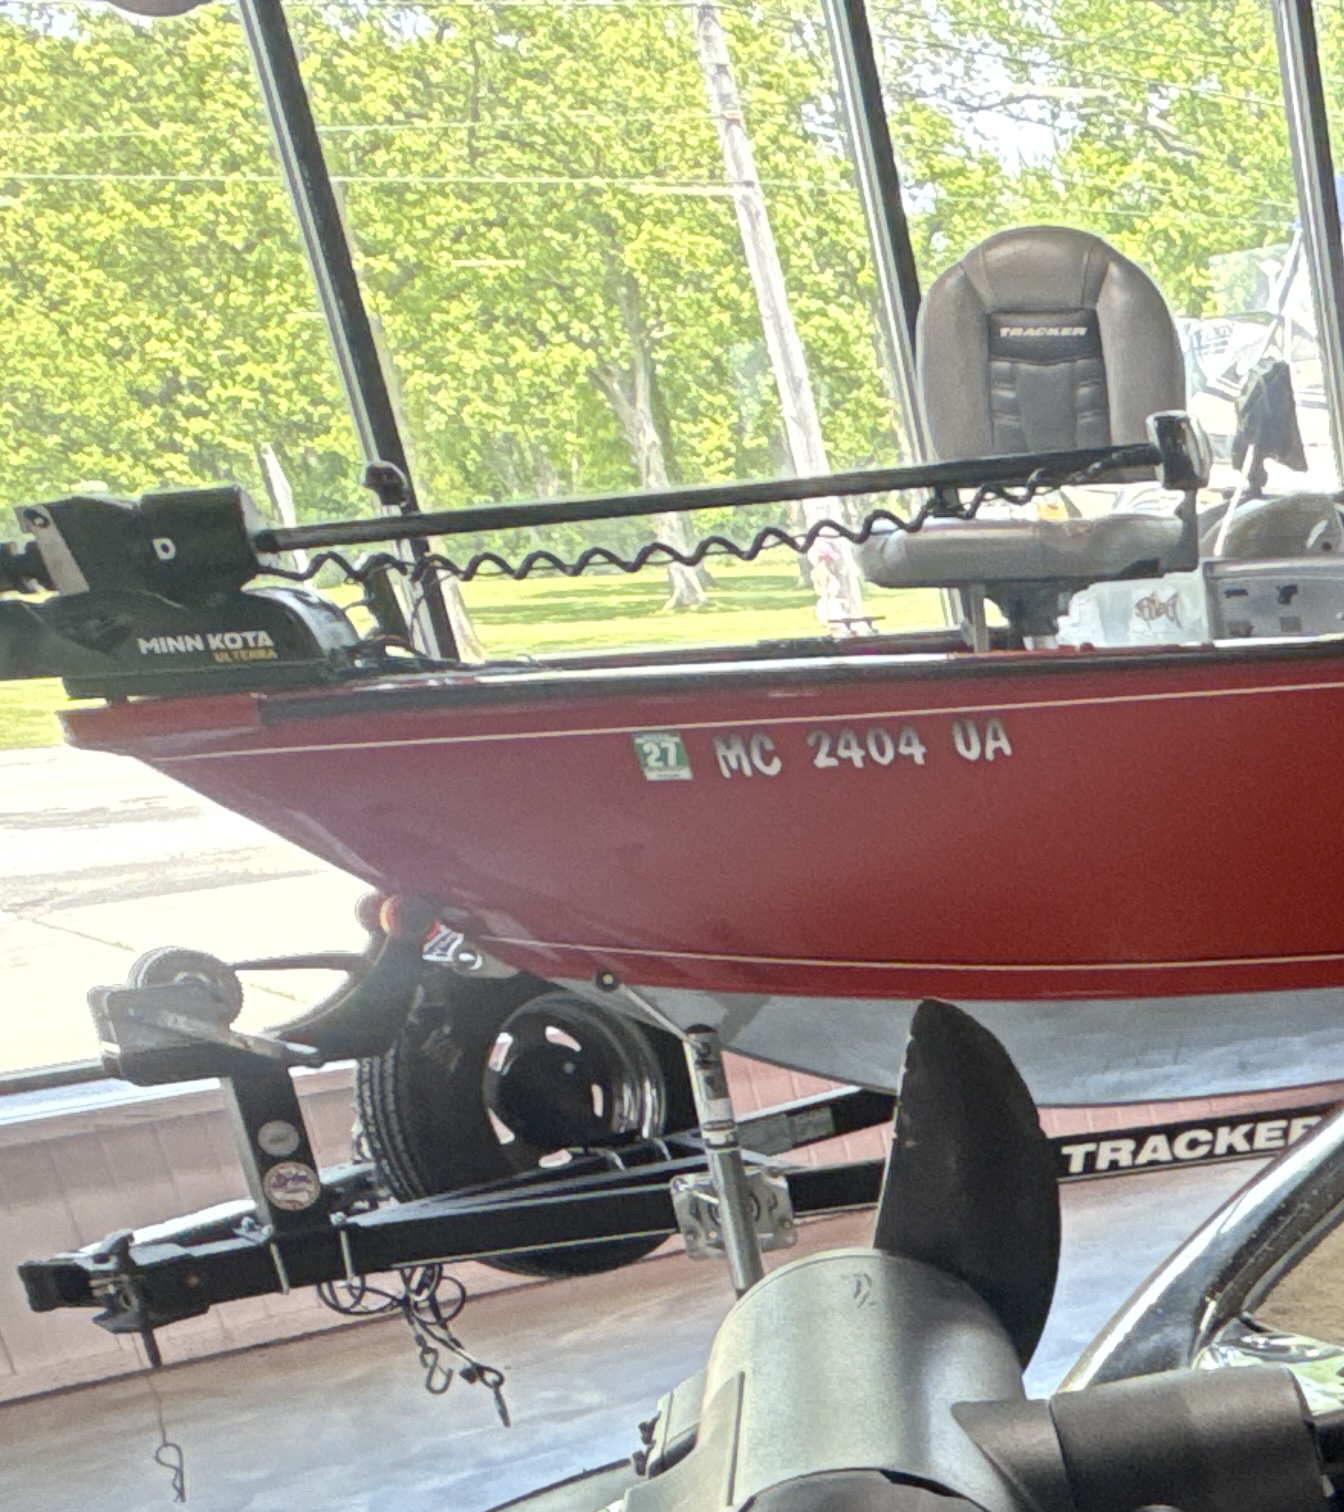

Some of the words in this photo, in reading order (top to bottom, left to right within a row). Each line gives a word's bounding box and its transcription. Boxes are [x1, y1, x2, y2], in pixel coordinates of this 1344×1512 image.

[136, 633, 205, 655] MINN
[206, 630, 274, 650] KOTA
[642, 741, 677, 768] 27
[712, 730, 782, 779] MC
[807, 725, 927, 769] 2404
